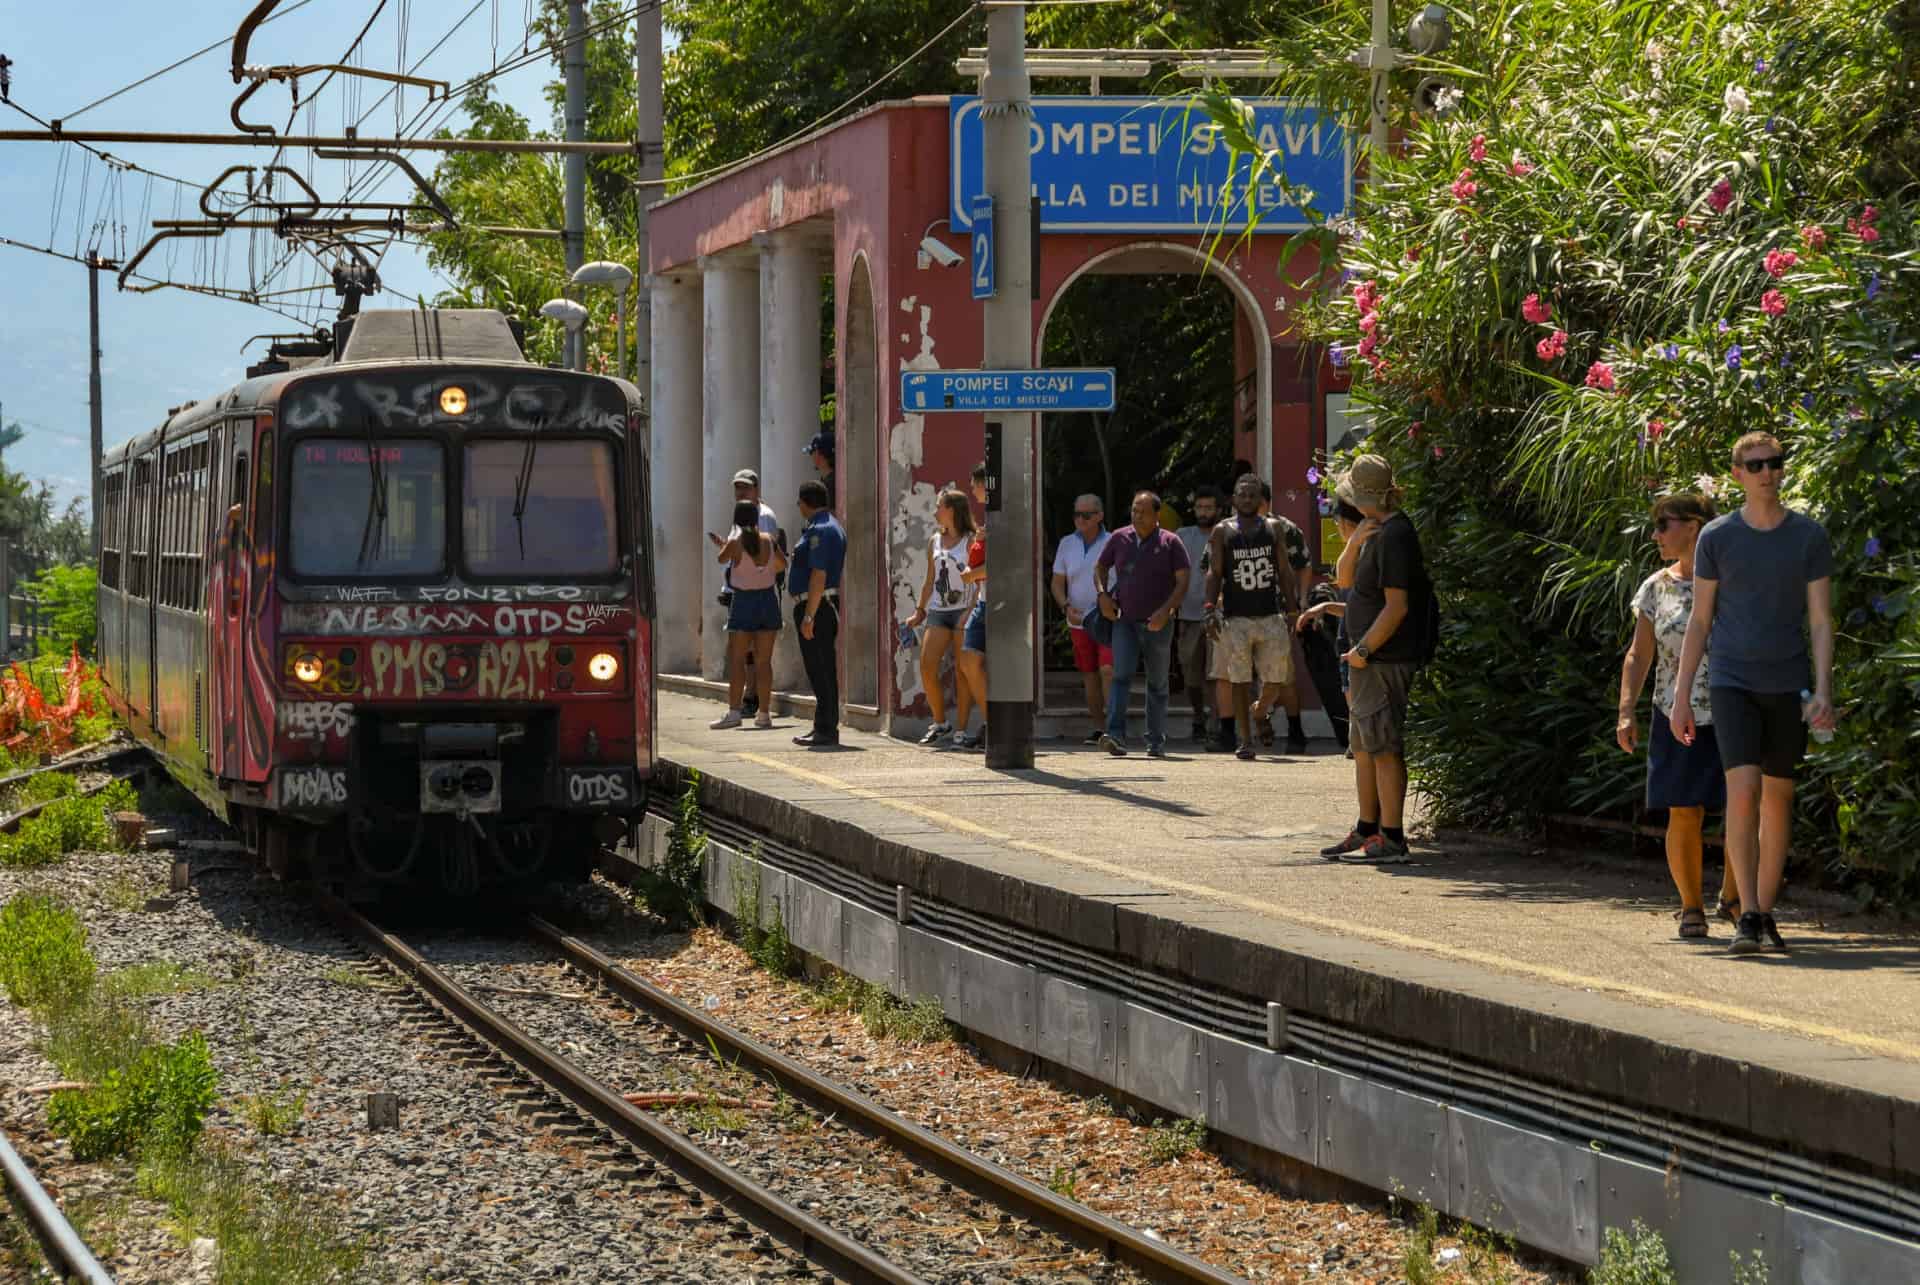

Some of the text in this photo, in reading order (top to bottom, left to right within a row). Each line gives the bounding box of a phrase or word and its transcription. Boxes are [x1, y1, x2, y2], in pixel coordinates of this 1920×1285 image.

[1029, 122, 1159, 156] OMPEI
[1109, 183, 1159, 208] DEI
[975, 233, 989, 288] 2
[943, 375, 1074, 392] POMPEI SCAVI
[958, 394, 1059, 406] VILLA DEI MISTERI
[1236, 557, 1273, 592] 82
